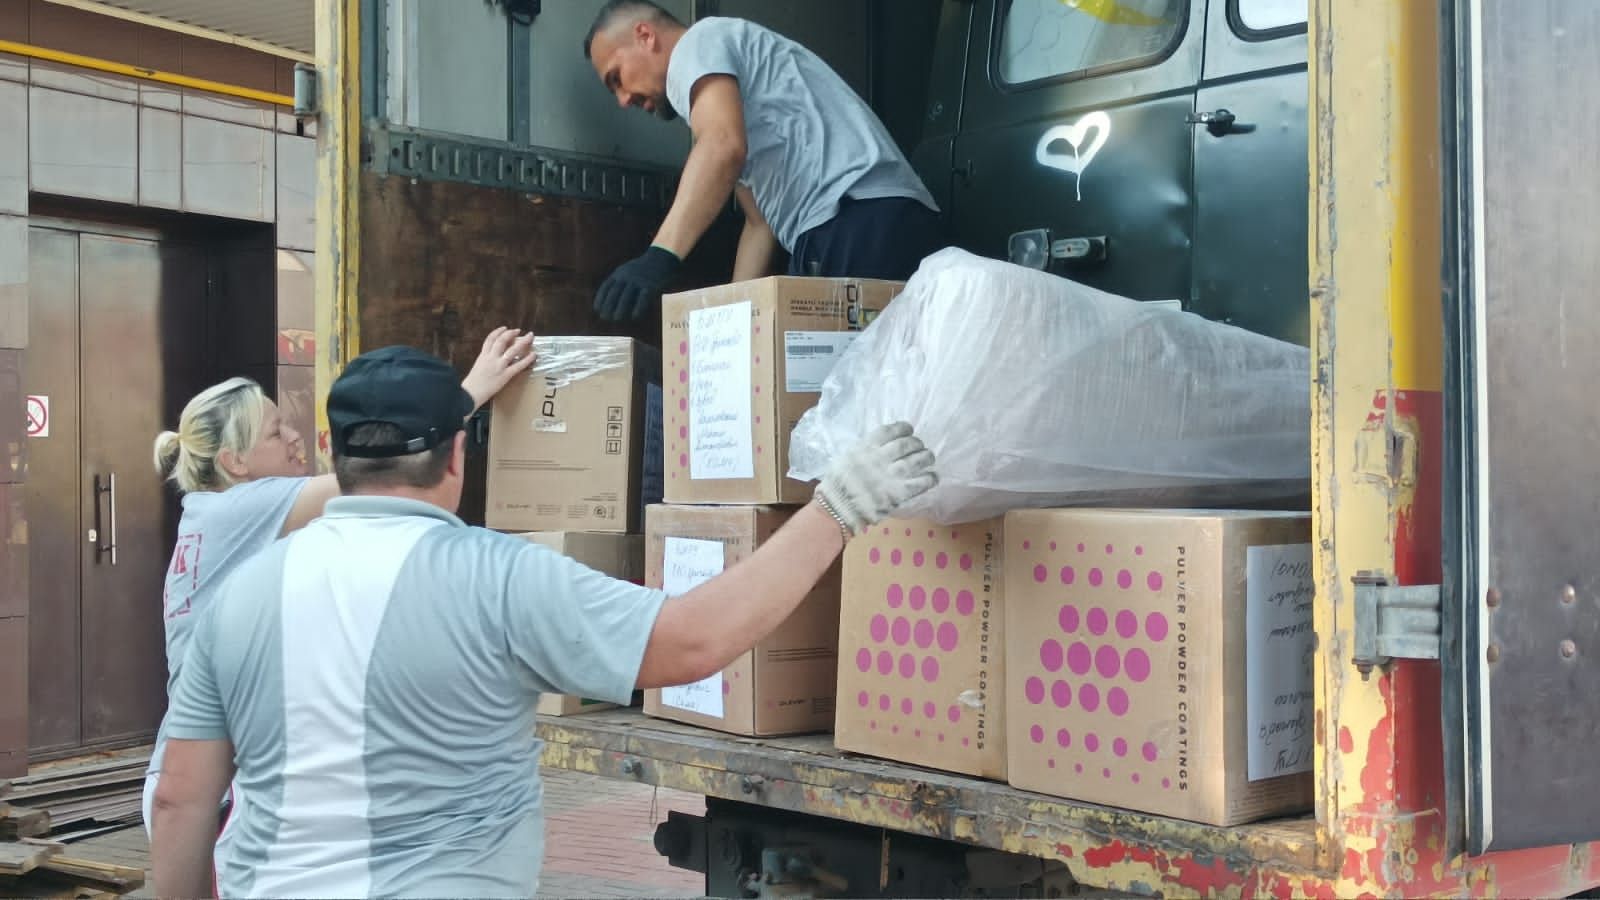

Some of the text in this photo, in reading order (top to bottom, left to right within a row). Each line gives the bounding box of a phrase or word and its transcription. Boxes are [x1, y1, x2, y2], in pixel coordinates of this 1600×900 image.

[976, 532, 993, 751] PULVER POWDER COATINGS
[1176, 545, 1189, 791] PULVER POWDER COATINGS
